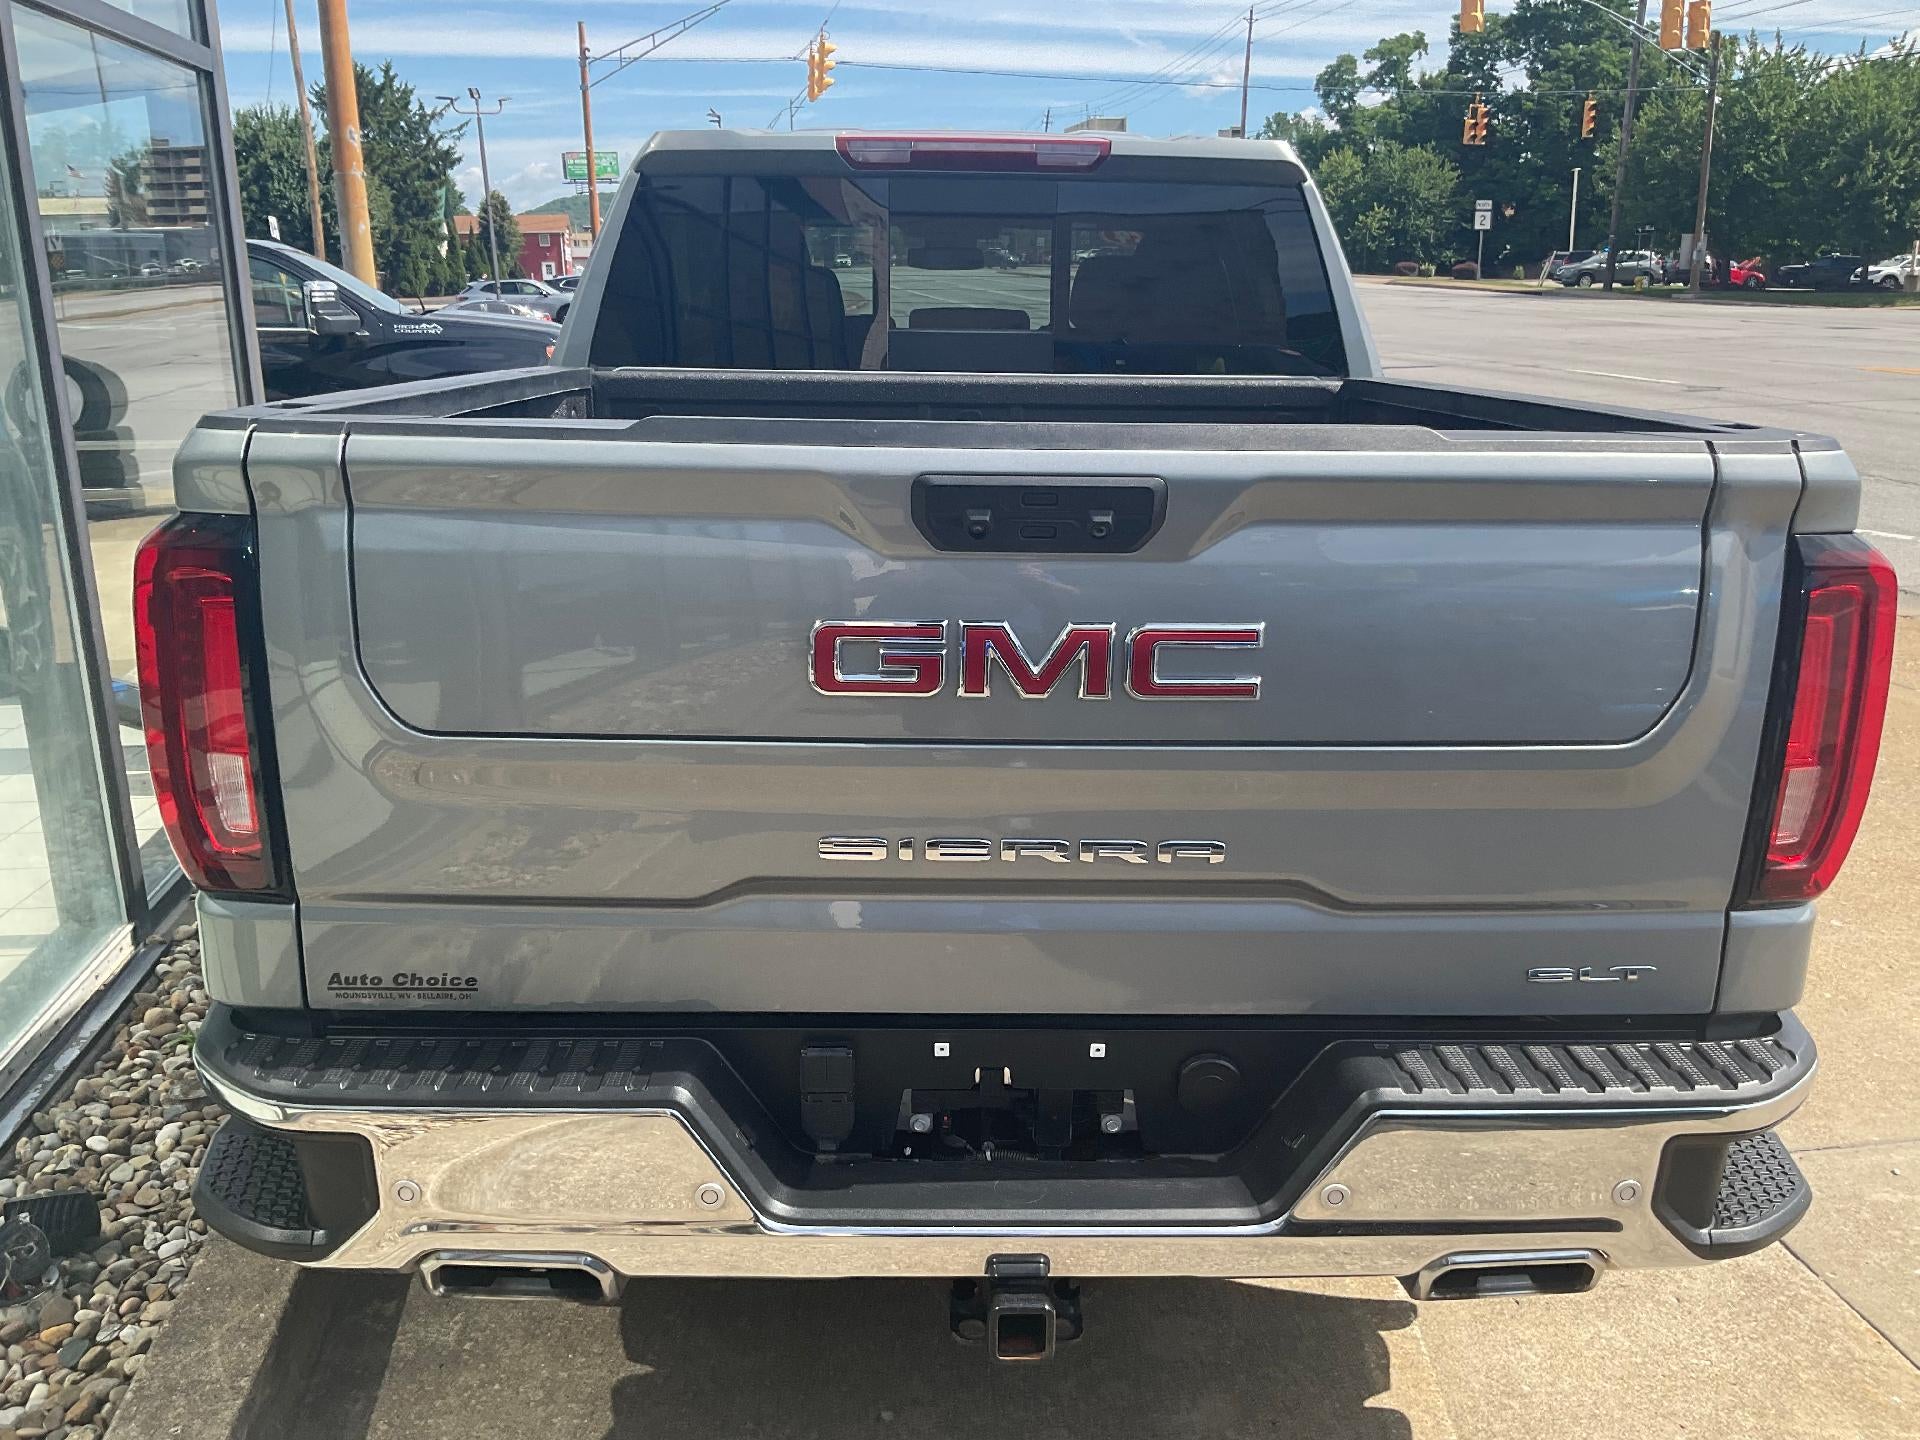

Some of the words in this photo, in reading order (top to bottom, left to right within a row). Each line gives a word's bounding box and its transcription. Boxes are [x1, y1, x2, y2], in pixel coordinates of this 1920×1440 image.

[1479, 214, 1486, 226] 2
[808, 619, 1266, 700] GMC
[818, 837, 1226, 864] SIERRA
[327, 972, 383, 986] Auto
[392, 972, 478, 987] Choice
[1527, 966, 1657, 982] SLT
[458, 992, 472, 1000] OH
